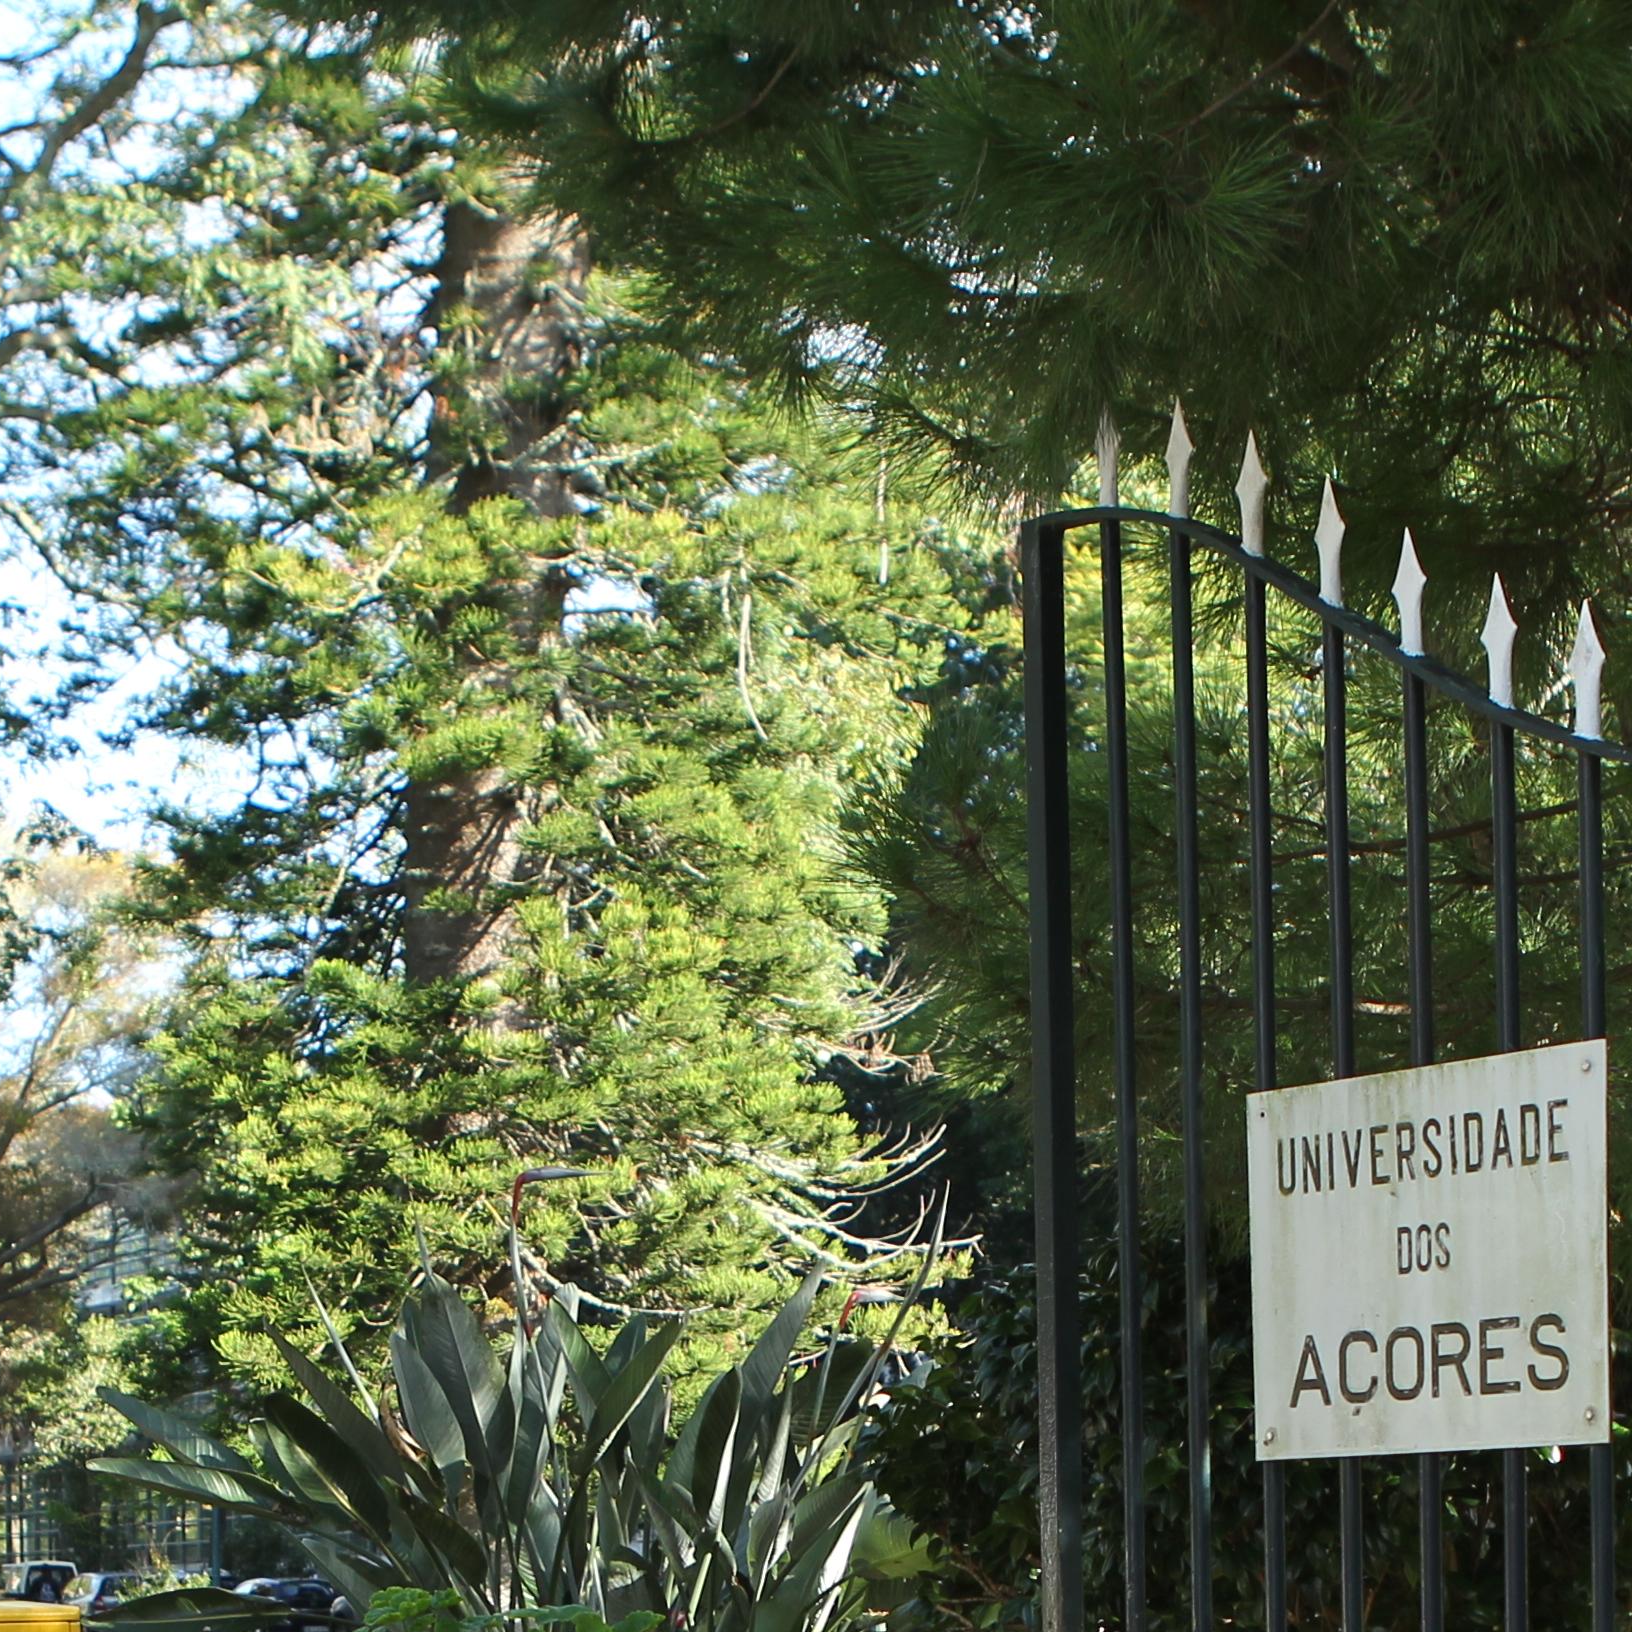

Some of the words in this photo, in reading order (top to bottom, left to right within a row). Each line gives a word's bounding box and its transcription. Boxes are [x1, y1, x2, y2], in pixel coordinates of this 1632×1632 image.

[1277, 1098, 1569, 1196] UNIVERSIDADE
[1397, 1222, 1451, 1275] DOS
[1289, 1312, 1570, 1416] AÇORES
